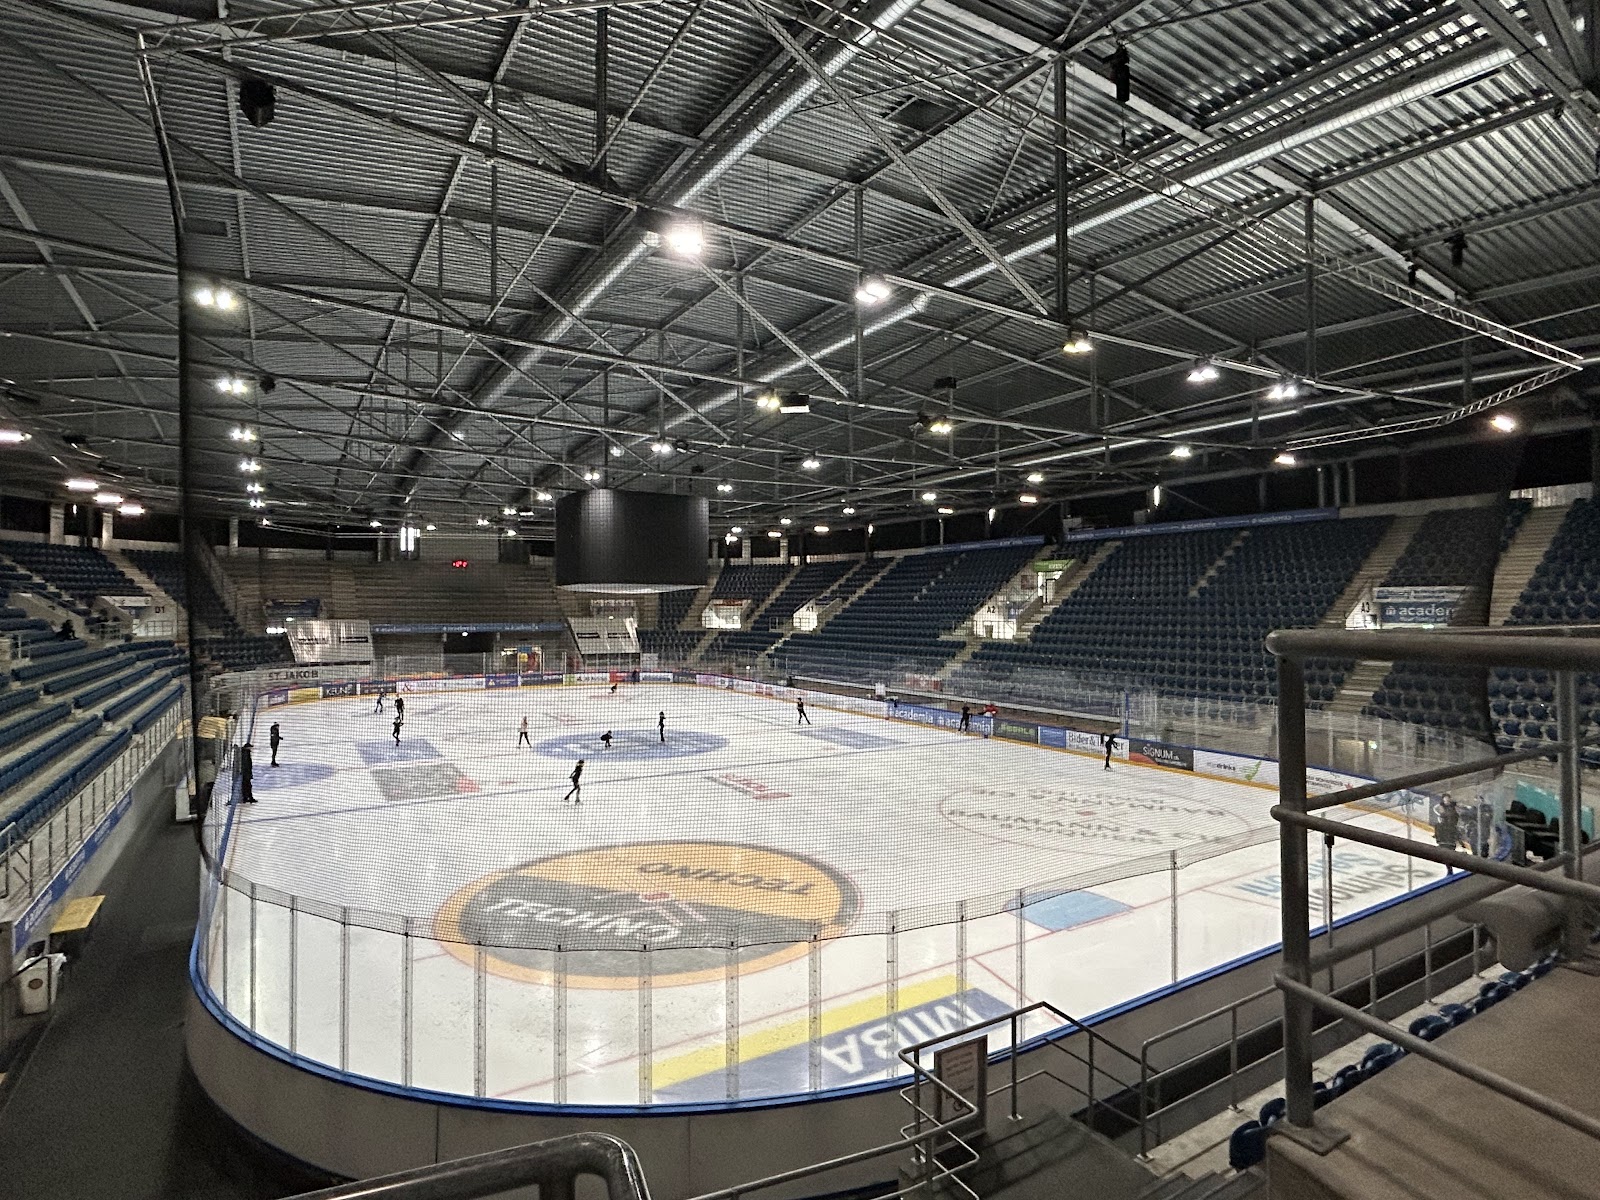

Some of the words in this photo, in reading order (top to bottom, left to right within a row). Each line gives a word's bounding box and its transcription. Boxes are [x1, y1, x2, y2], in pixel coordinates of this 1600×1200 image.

[285, 670, 319, 680] JAKOB
[1068, 731, 1088, 745] Bider
[947, 808, 1122, 833] BAUMANN
[636, 862, 821, 896] TECHNO
[485, 897, 682, 943] TECHNO
